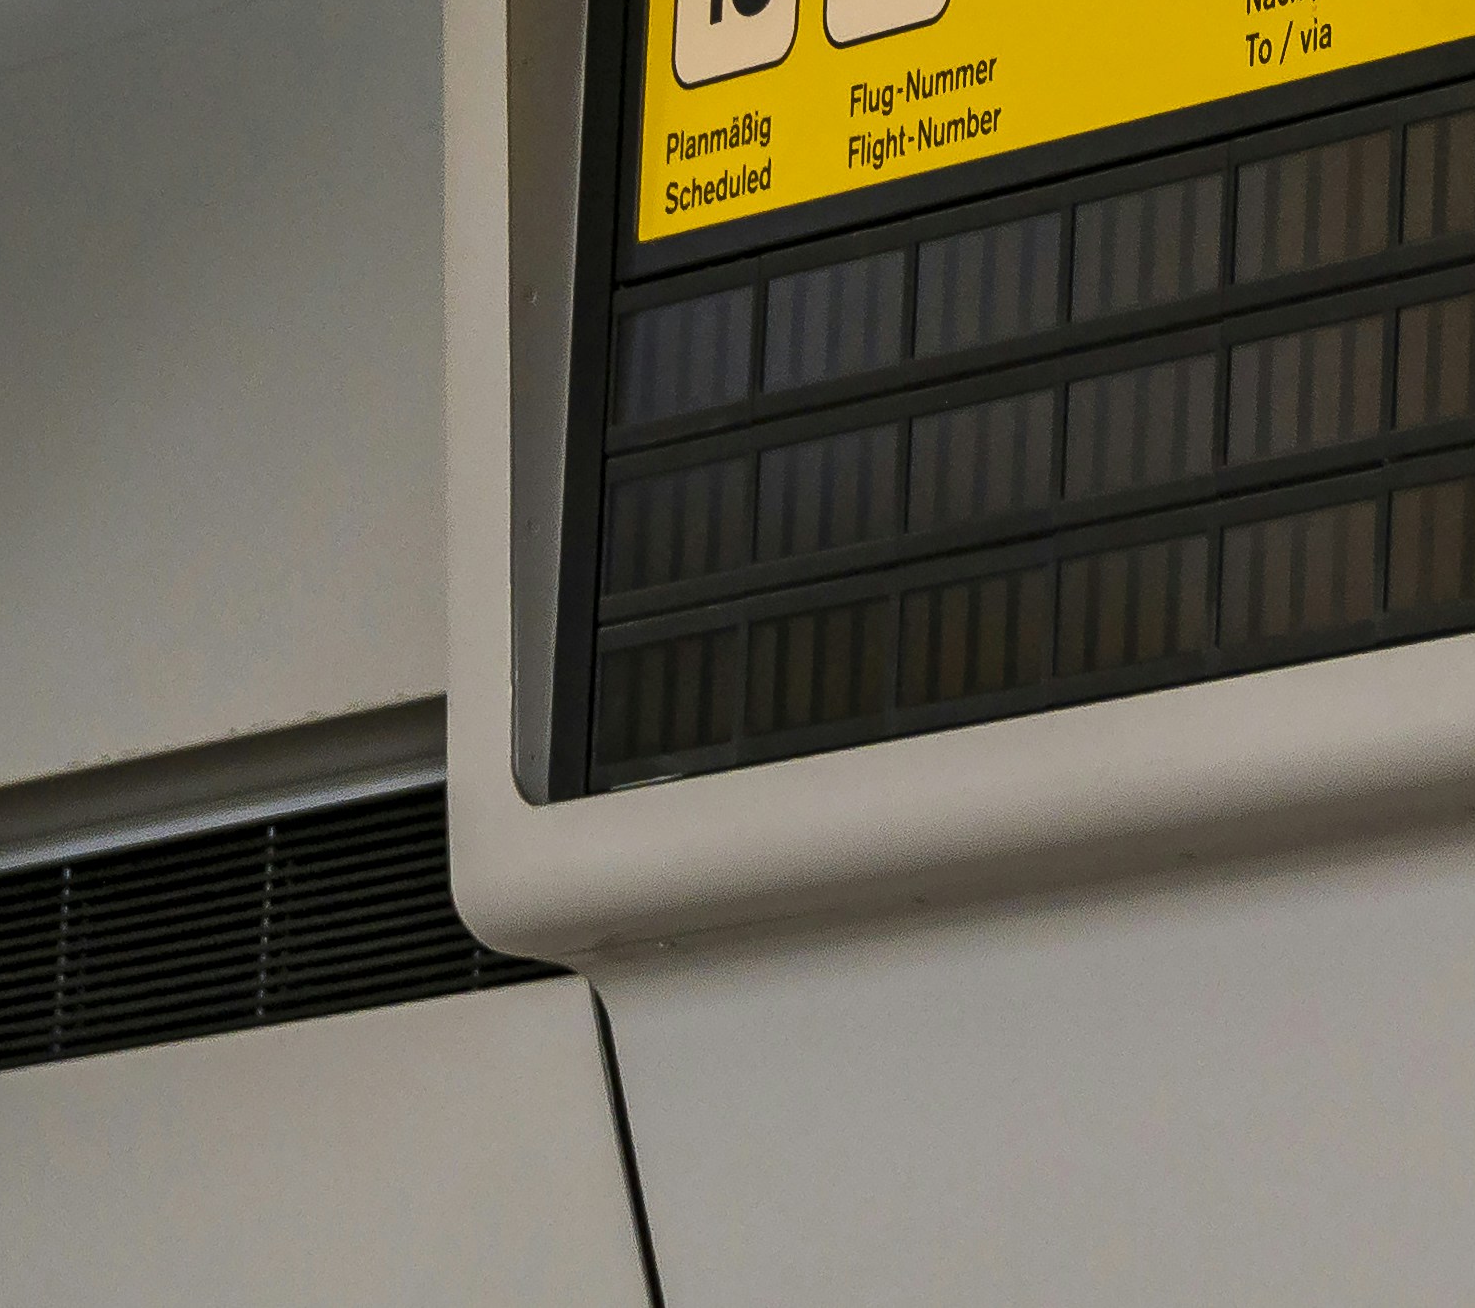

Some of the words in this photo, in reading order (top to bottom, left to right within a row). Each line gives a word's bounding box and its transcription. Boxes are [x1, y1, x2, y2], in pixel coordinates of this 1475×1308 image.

[1245, 32, 1273, 68] To
[1300, 17, 1332, 55] via
[850, 57, 998, 118] Flug-Nummer
[666, 110, 772, 165] Planmäßig
[848, 106, 1002, 169] Flight-Number
[664, 157, 772, 215] Scheduled
